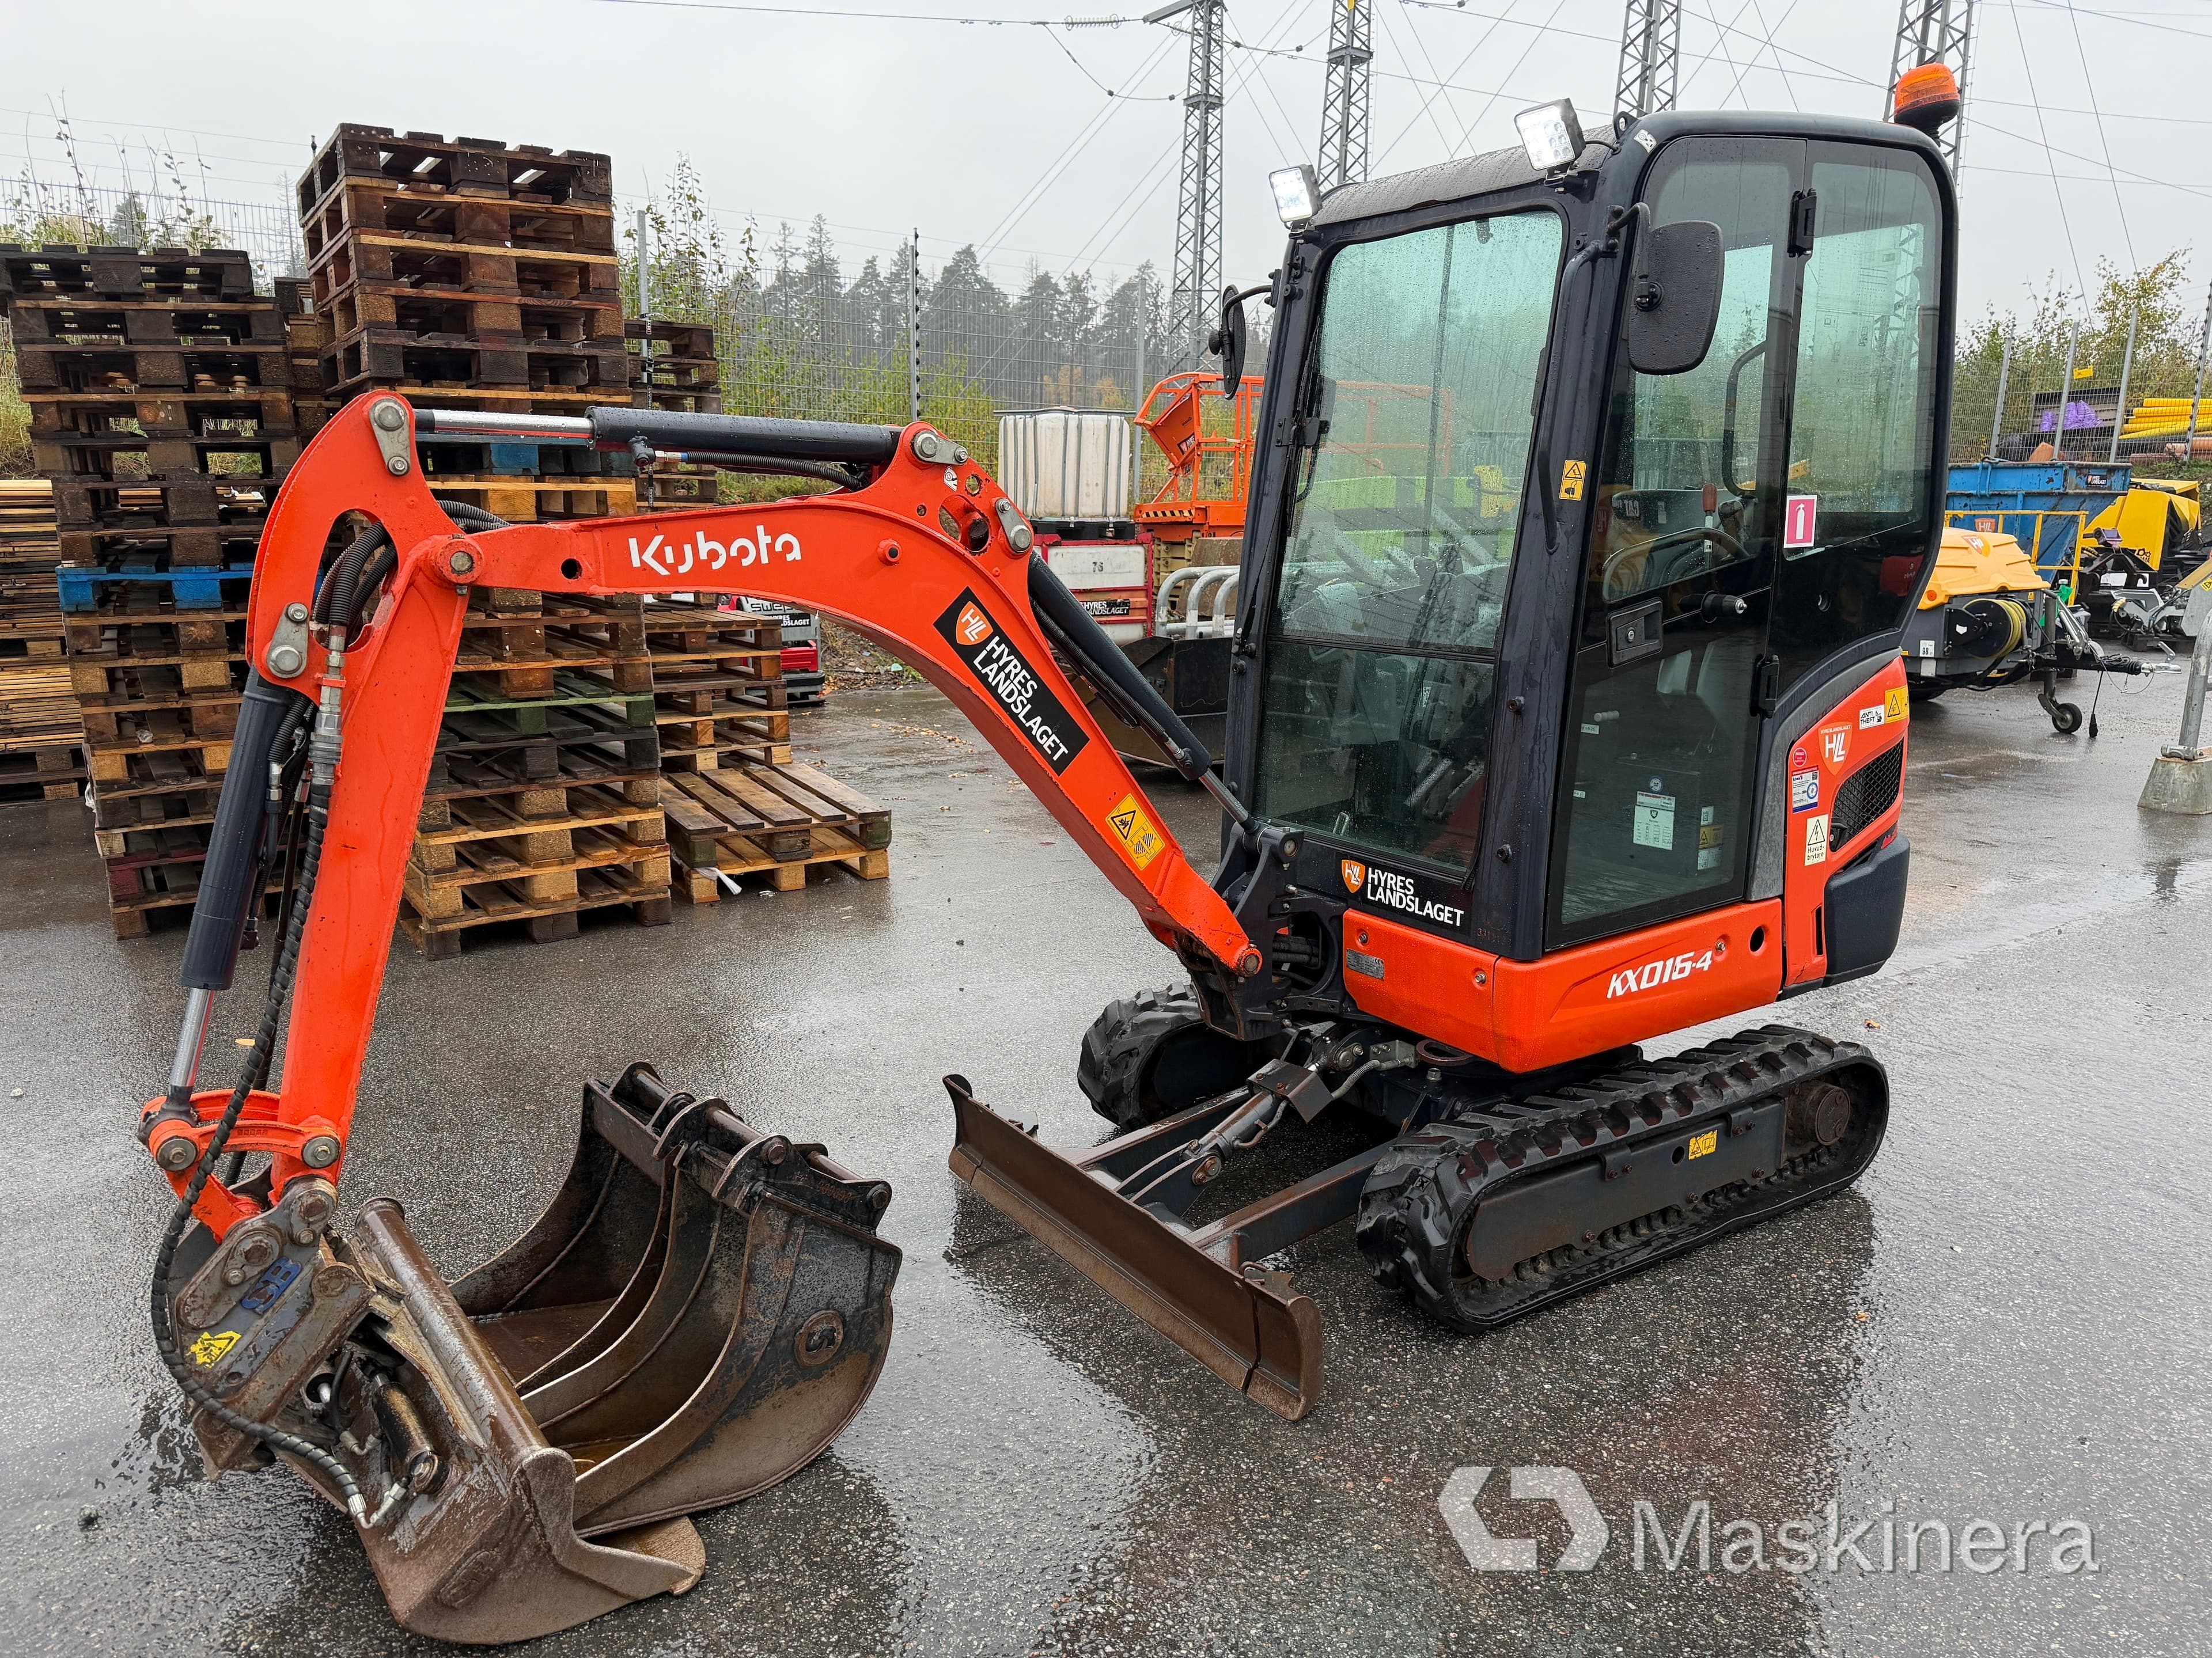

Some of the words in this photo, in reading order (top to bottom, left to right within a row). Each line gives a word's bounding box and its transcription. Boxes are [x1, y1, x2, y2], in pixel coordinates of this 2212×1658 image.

[628, 525, 801, 575] Kubota
[1084, 601, 1107, 609] HYRES
[1088, 606, 1129, 615] ANDSLAGET
[1922, 647, 1929, 655] 98
[985, 635, 1038, 699] HYRES
[973, 649, 1069, 761] LANDSLAGET
[1861, 711, 1873, 719] ANTI
[1860, 716, 1876, 725] THEFT
[1806, 851, 1824, 862] brytare
[1368, 867, 1415, 896] HYRES
[1366, 882, 1465, 927] LANDSLAGET
[1606, 950, 1718, 999] KX016-4
